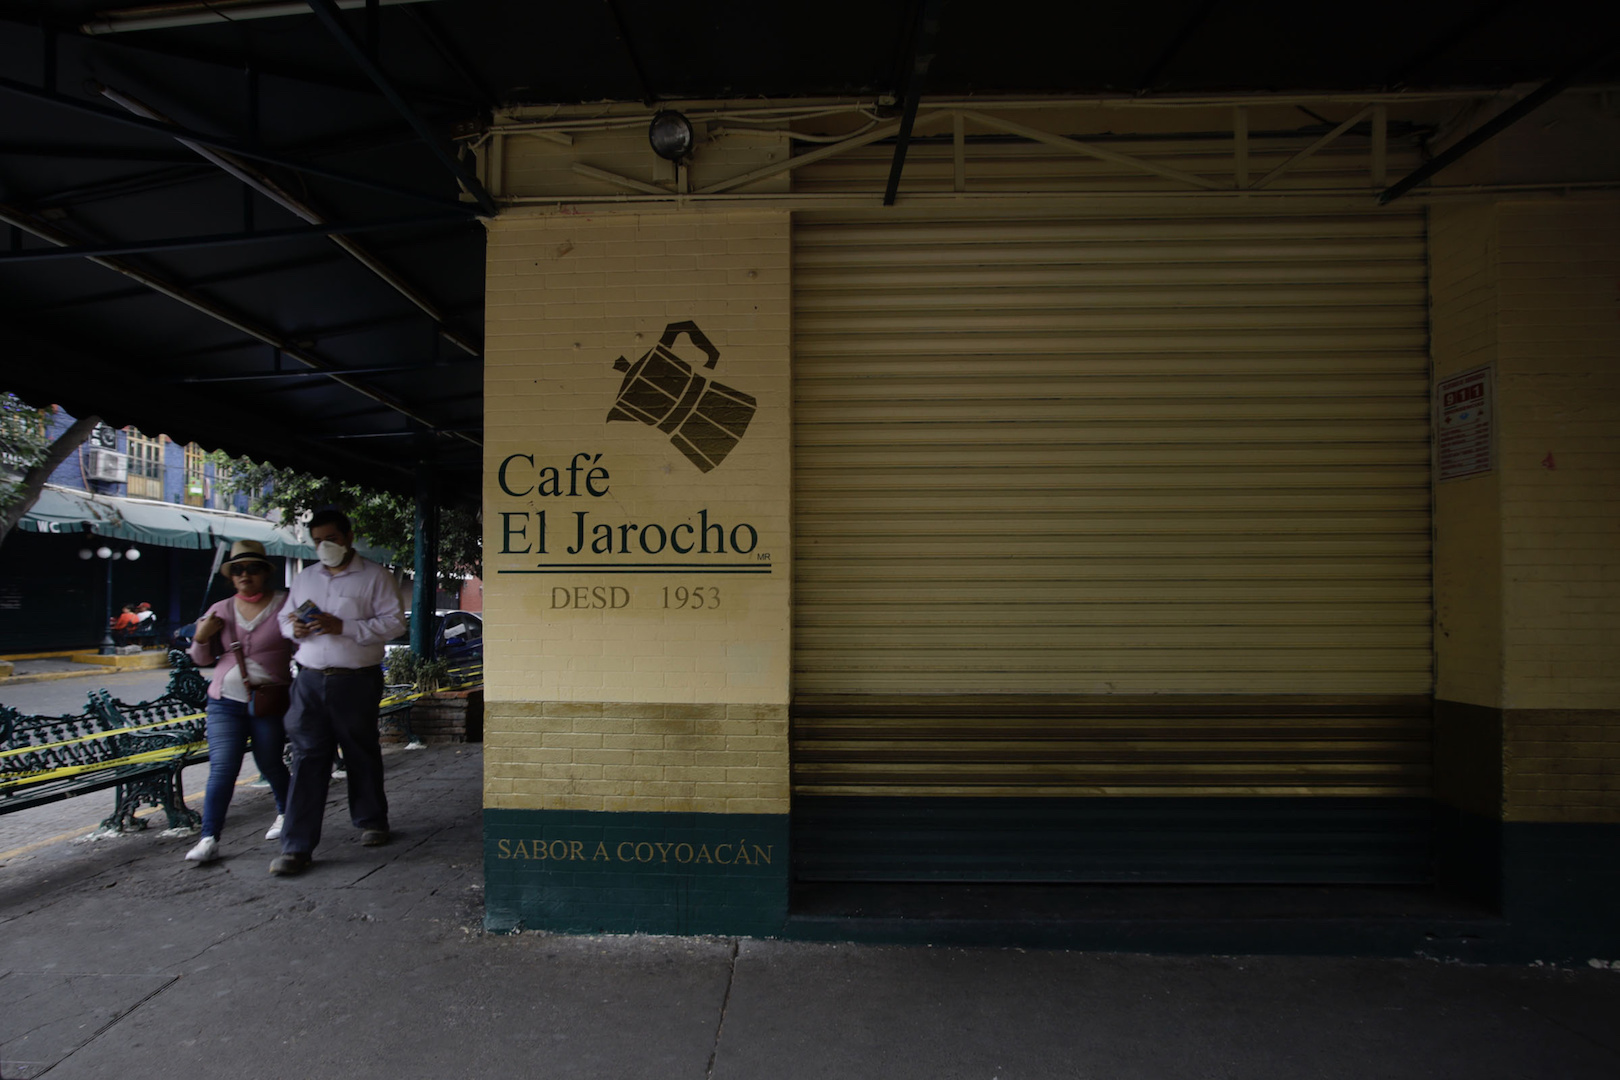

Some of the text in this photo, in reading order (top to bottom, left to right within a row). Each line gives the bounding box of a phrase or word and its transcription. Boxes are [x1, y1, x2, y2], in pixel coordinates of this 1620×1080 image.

[1445, 384, 1482, 405] 911
[498, 453, 610, 497] Café
[37, 520, 61, 533] WC
[497, 509, 758, 554] El Jarocho
[757, 553, 771, 561] MR
[551, 586, 721, 610] DESD 1953
[498, 839, 773, 865] SABOR A COYOACÁN
